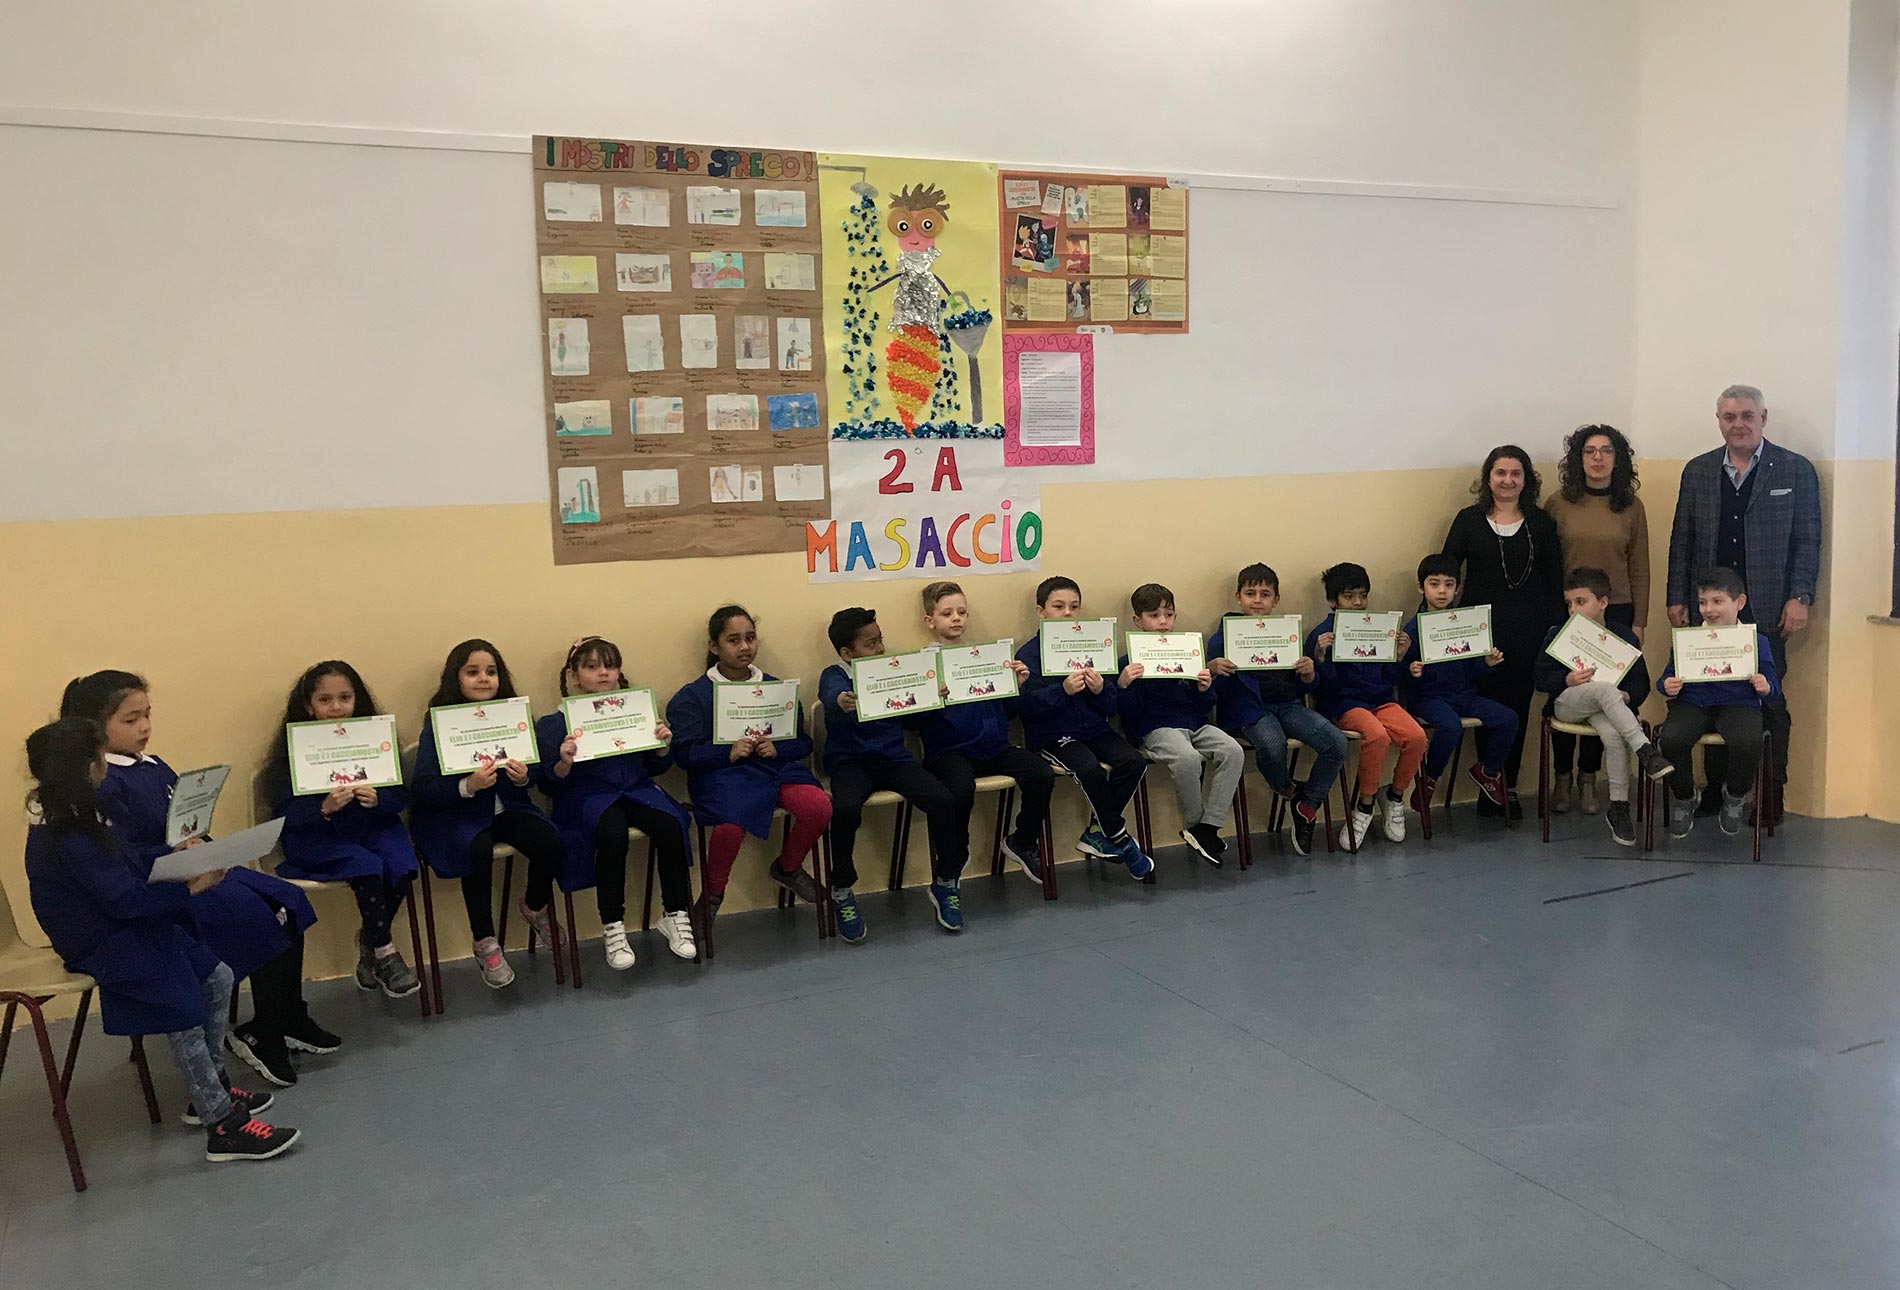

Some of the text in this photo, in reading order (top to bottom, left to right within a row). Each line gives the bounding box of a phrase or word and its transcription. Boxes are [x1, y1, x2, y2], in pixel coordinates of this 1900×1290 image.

[546, 137, 554, 167] I
[561, 139, 634, 169] MOSTRI
[644, 146, 700, 172] DELLO
[879, 447, 962, 494] 2 A
